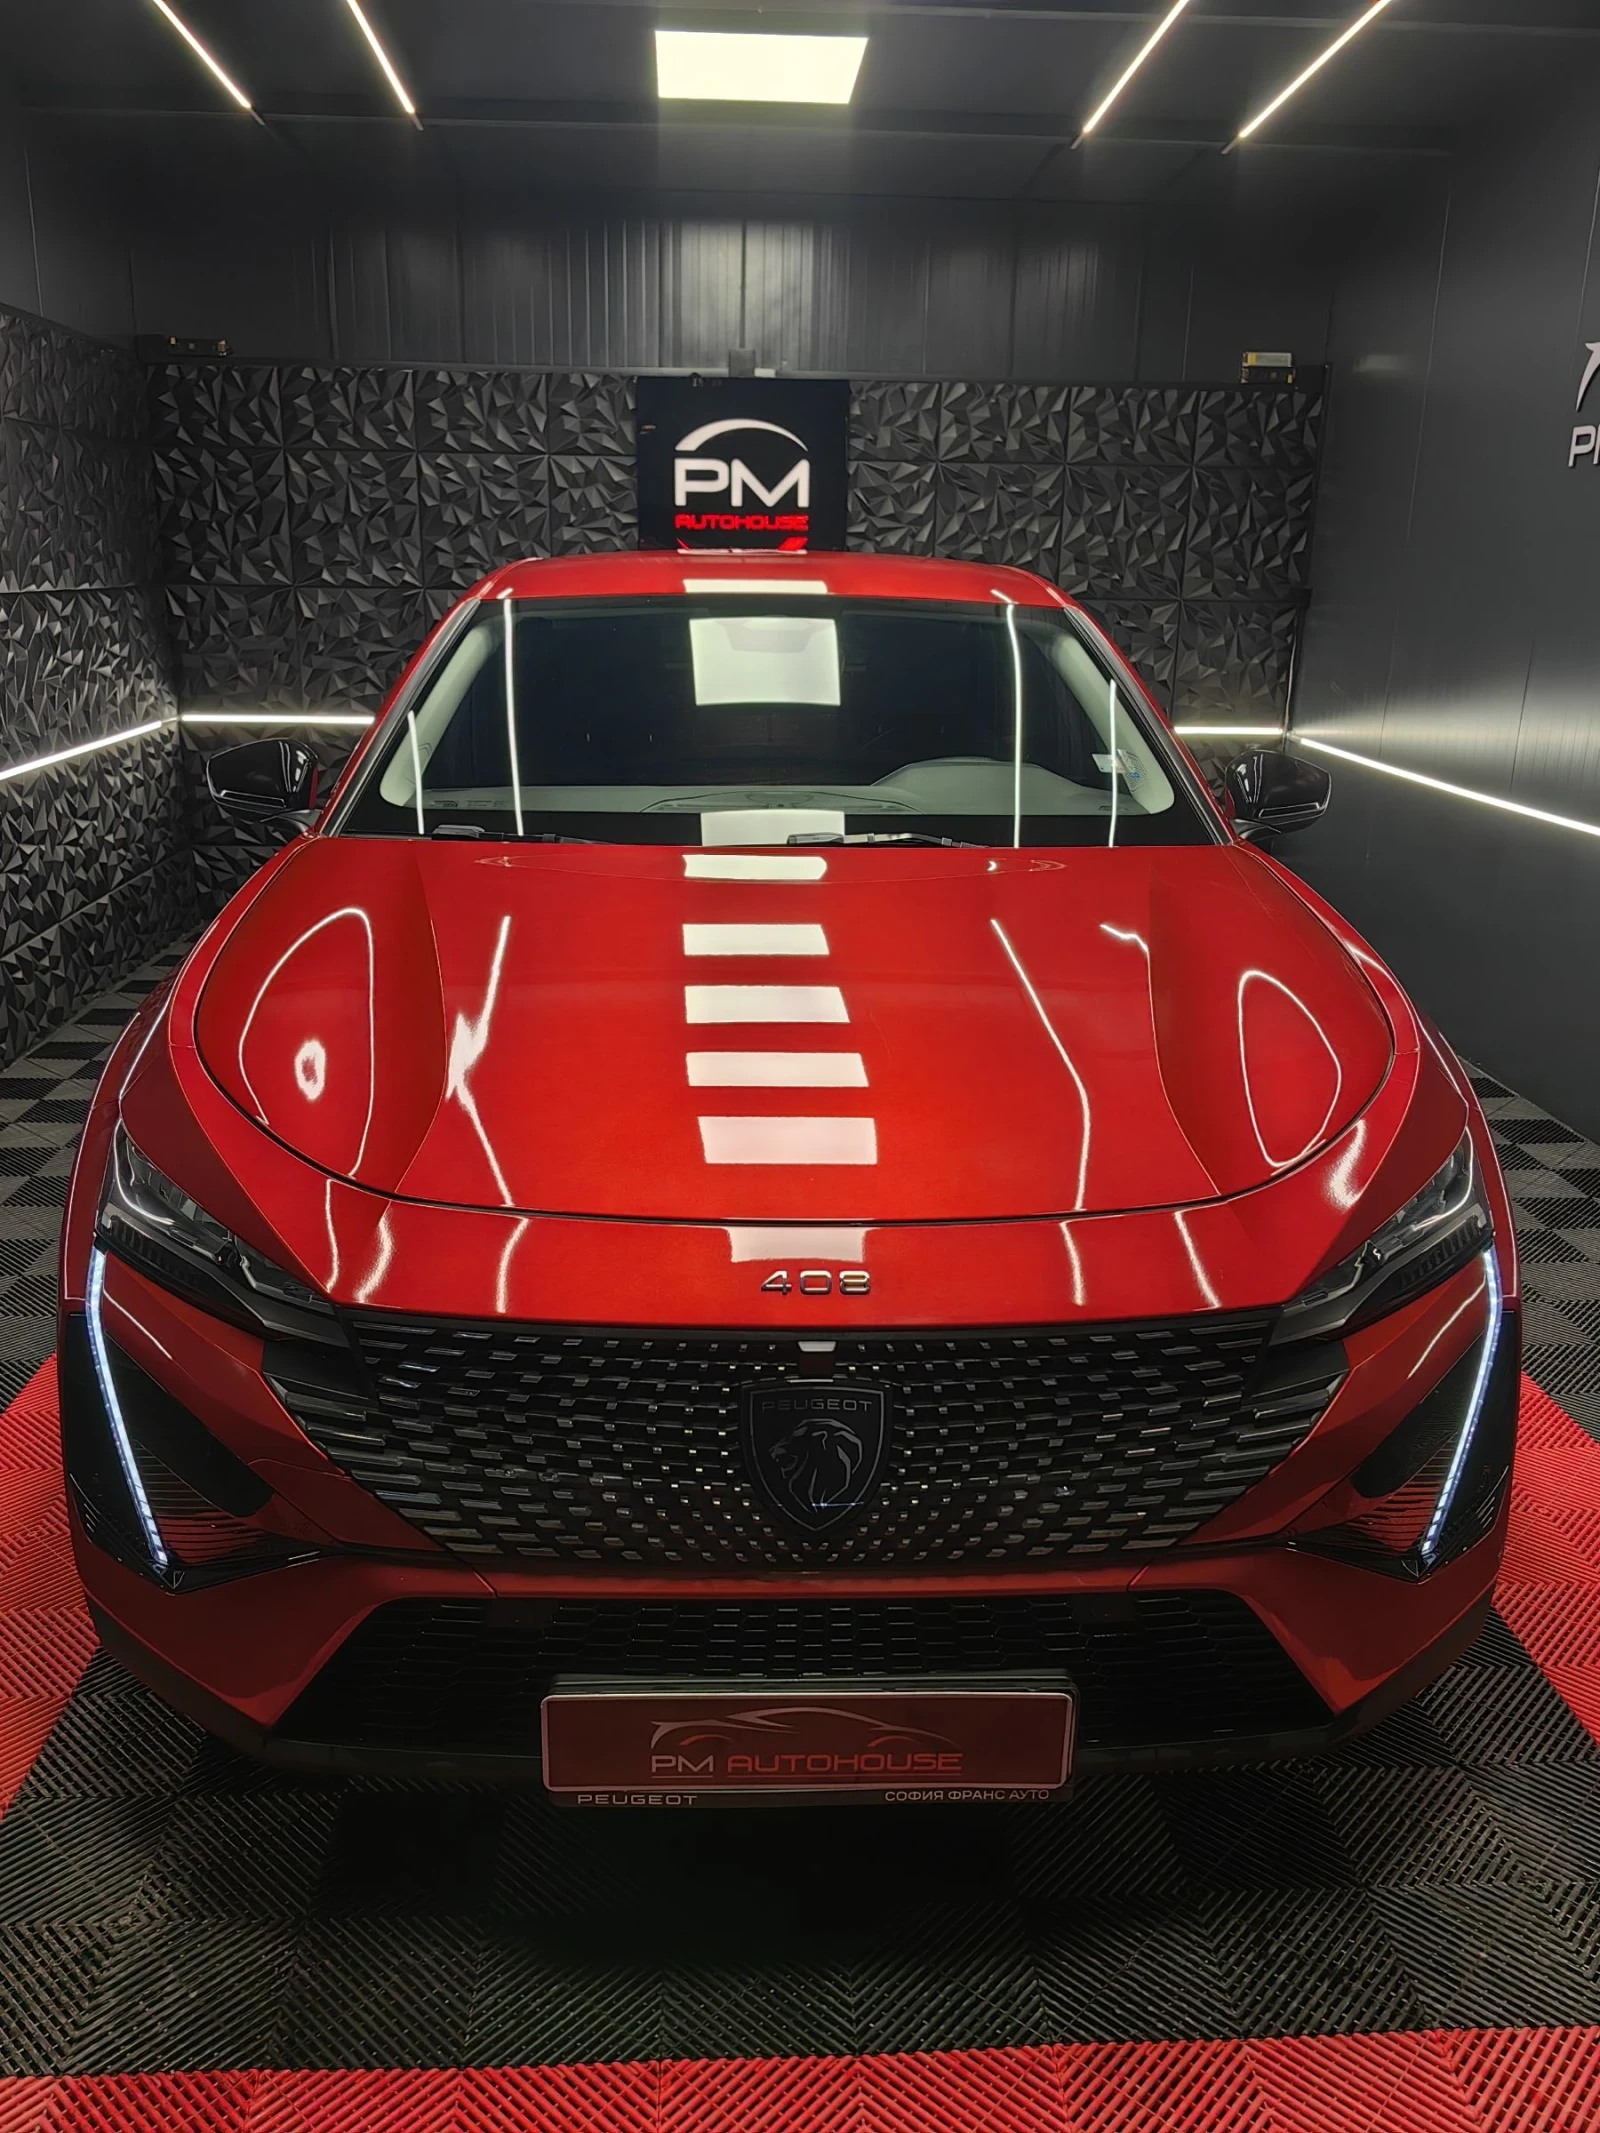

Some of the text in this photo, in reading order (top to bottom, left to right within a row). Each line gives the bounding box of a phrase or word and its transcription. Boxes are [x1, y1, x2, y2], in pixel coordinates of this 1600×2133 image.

[674, 458, 810, 508] PM
[674, 514, 809, 531] AUTOHOUSE
[760, 1270, 870, 1295] 408
[761, 1398, 873, 1412] PEUGEOT
[651, 1753, 963, 1773] PM AUTOHOUSE
[577, 1794, 698, 1805] PEUGEOT
[885, 1789, 1050, 1802] СОФИЯ ФРАНС АУТО
